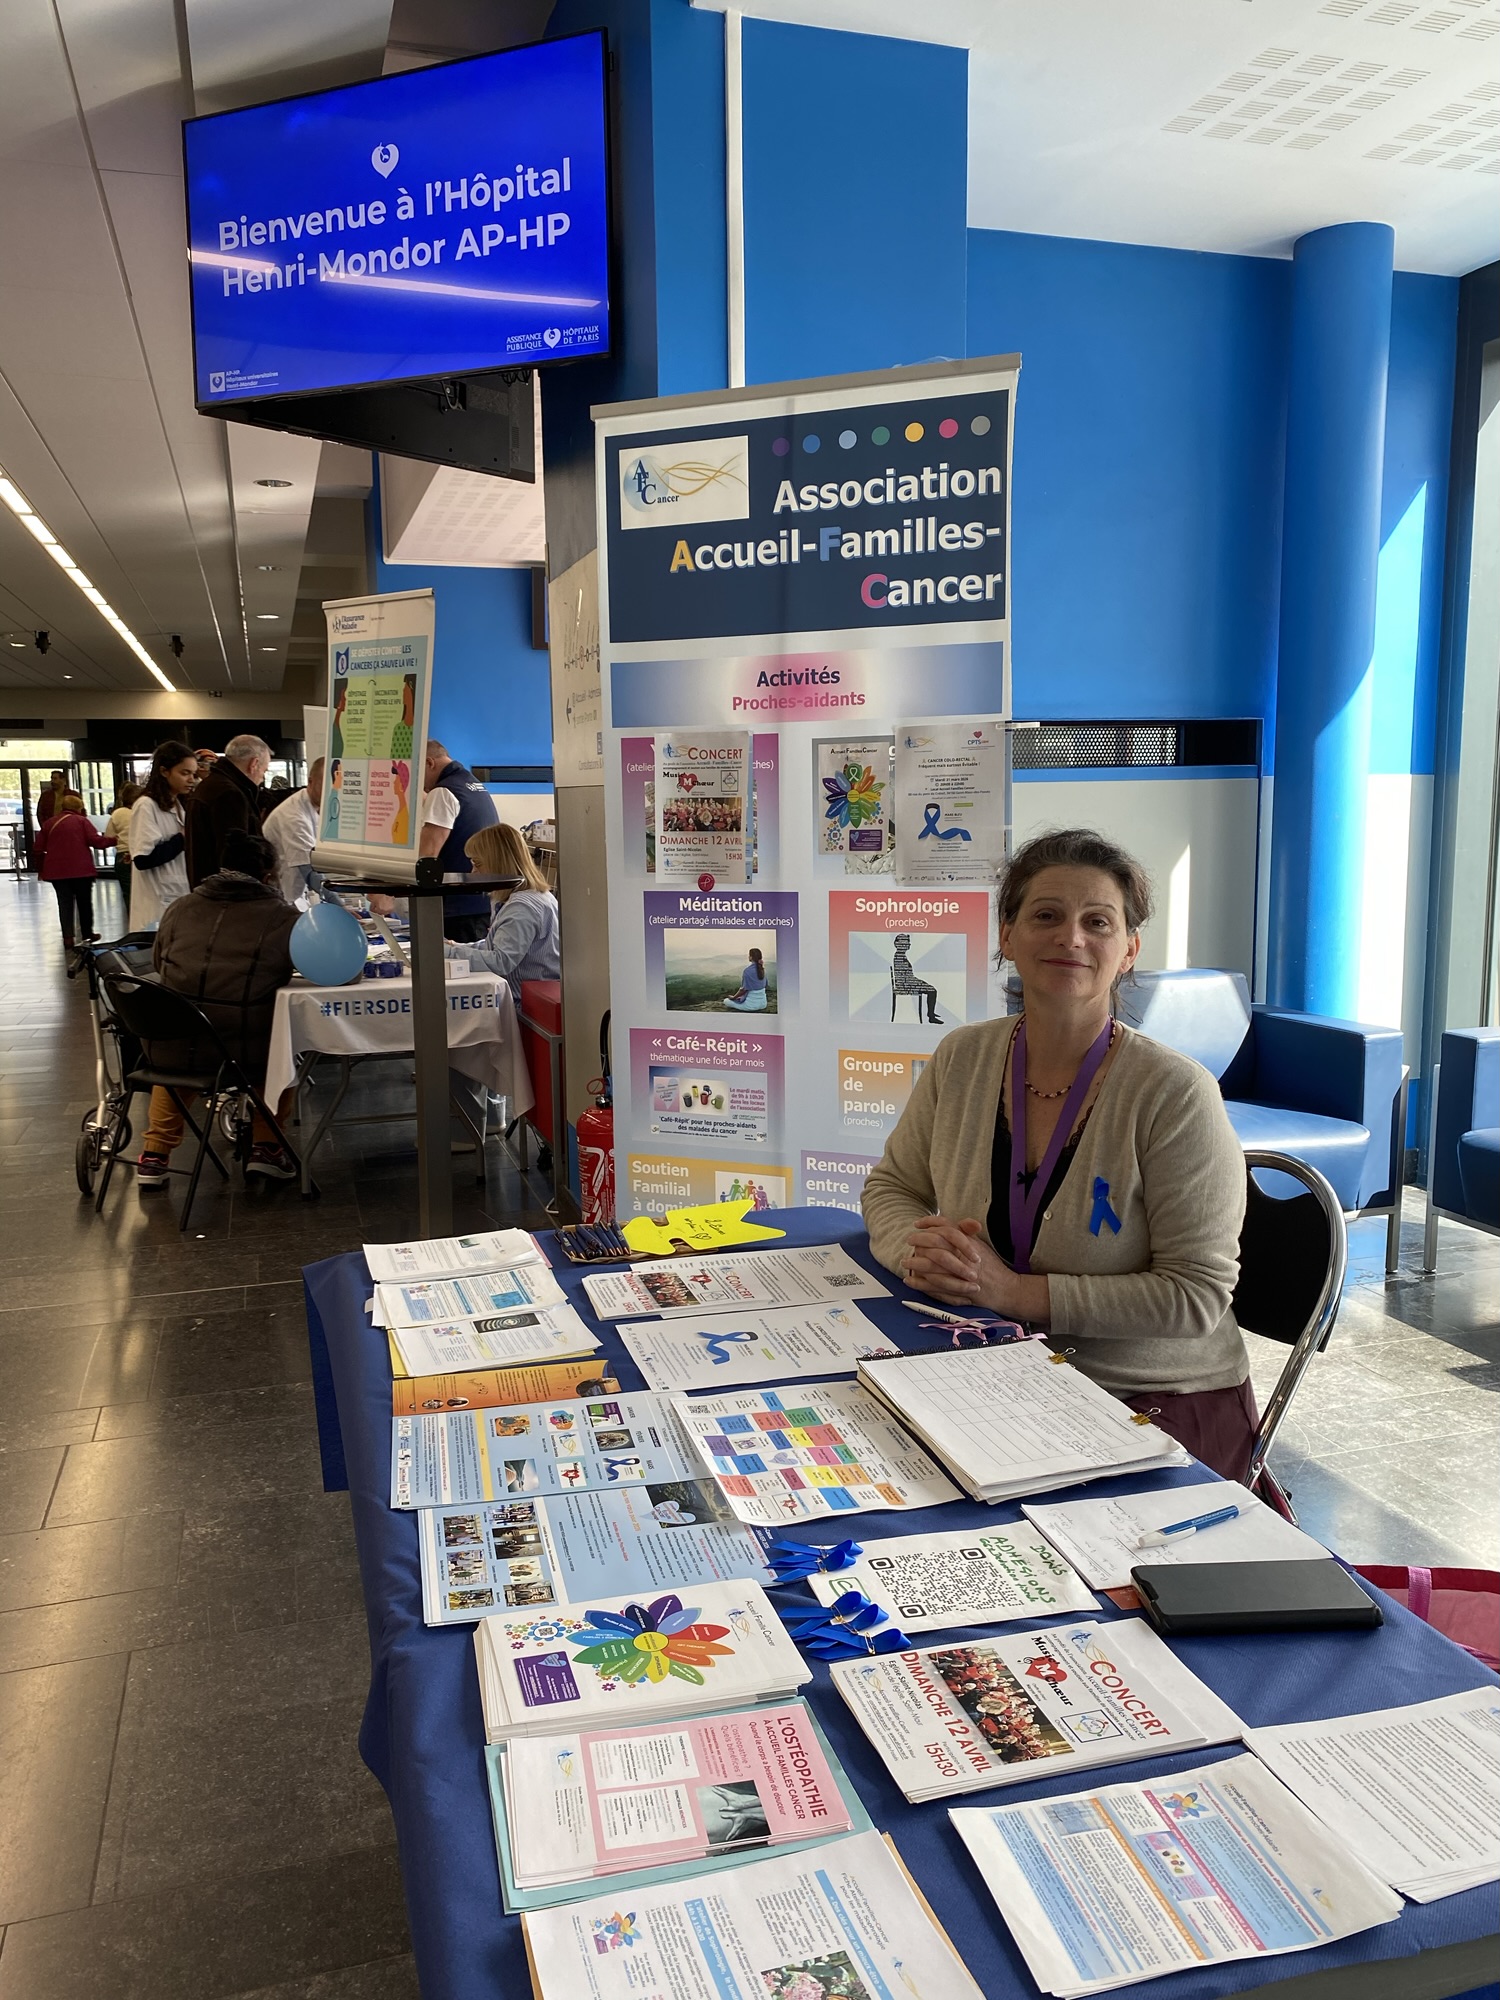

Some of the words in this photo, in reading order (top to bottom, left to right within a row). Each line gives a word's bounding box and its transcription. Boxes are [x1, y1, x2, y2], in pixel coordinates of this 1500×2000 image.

[218, 200, 386, 251] Bienvenue
[397, 187, 414, 219] à
[425, 157, 571, 216] l'Hôpital
[223, 237, 446, 296] Henri-Mondor
[455, 213, 571, 261] AP-HP
[506, 333, 542, 344] ASSISTANCE
[563, 325, 599, 336] HÔPITAUX
[578, 333, 599, 342] PARIS
[506, 341, 542, 351] PUBLIQUE
[773, 462, 1001, 514] Association
[670, 516, 1001, 573] Accueil-Familles-
[861, 572, 1001, 609] Cancer
[341, 622, 357, 630] Maladie
[402, 645, 411, 654] LES
[350, 661, 372, 670] CANCERS
[380, 659, 398, 668] SAUVE
[398, 659, 405, 667] LA
[406, 658, 414, 667] VIE
[756, 665, 840, 688] Activités
[732, 691, 866, 711] Proches-aidants
[688, 748, 742, 760] CONCERT
[684, 778, 692, 786] M
[660, 836, 708, 845] DIMANCHE
[711, 836, 722, 845] 12
[679, 898, 762, 912] Méditation
[855, 898, 960, 916] Sophrologie
[649, 916, 677, 925] (atelier
[679, 916, 710, 926] partagé
[712, 916, 745, 925] malades
[759, 917, 794, 927] proches)
[885, 917, 928, 928] (proches)
[652, 1038, 662, 1048] «
[666, 1036, 748, 1055] Café-Répit
[752, 1043, 762, 1052] »
[650, 1053, 694, 1064] thématique
[713, 1056, 727, 1065] fois
[730, 1059, 743, 1067] par
[745, 1059, 765, 1067] mois
[843, 1057, 904, 1076] Groupe
[843, 1077, 863, 1091] de
[844, 1100, 896, 1114] parole
[714, 1121, 757, 1129] proches-aidants
[843, 1116, 884, 1129] (proches)
[632, 1161, 689, 1177] Soutien
[806, 1157, 873, 1175] Rencont
[633, 1180, 691, 1196] Familial
[806, 1179, 849, 1194] entre
[633, 1197, 642, 1211] à
[807, 1197, 862, 1214] Endeui
[1028, 1543, 1068, 1576] DONS
[744, 1599, 759, 1615] Accueil
[753, 1614, 769, 1630] Famille
[761, 1630, 778, 1646] Cancer
[1029, 1636, 1062, 1665] Music'
[1034, 1663, 1057, 1676] M
[876, 1661, 892, 1676] place
[901, 1699, 925, 1725] Saint-Maur
[885, 1660, 904, 1676] Eglise
[896, 1676, 926, 1709] Saint-Nicolas
[896, 1651, 959, 1717] DIMANCHE
[1043, 1676, 1076, 1706] Chœur
[1084, 1674, 1148, 1739] Accueil-Familles-Cancer
[1085, 1659, 1175, 1737] CONCERT
[747, 1721, 761, 1738] Quand
[942, 1718, 971, 1736] 12
[719, 1725, 732, 1742] Quels
[726, 1743, 742, 1772] bénéfices
[729, 1723, 749, 1764] L'ostéopathie
[755, 1745, 766, 1760] corps
[922, 1741, 959, 1777] 15H30
[955, 1737, 993, 1773] AVRIL
[764, 1725, 782, 1754] ACCUEIL
[775, 1754, 794, 1788] FAMILLES
[787, 1788, 805, 1819] CANCER
[764, 1765, 776, 1783] besoin
[776, 1716, 828, 1817] L'OSTÉOPATHIE
[770, 1783, 779, 1791] de
[773, 1792, 787, 1815] douceur
[693, 1900, 708, 1926] L'atelier
[839, 1885, 851, 1899] pour
[847, 1900, 856, 1908] les
[853, 1910, 870, 1935] malades
[840, 1872, 853, 1888] Fiche
[849, 1889, 863, 1908] Atelier
[861, 1914, 887, 1950] Sophrologie
[848, 1875, 890, 1943] Accueil-Familles-Cancer
[686, 1903, 695, 1916] 14h
[693, 1921, 705, 1941] 15h30
[704, 1926, 711, 1934] de
[830, 1901, 842, 1912] Des
[837, 1913, 849, 1925] clés
[843, 1926, 856, 1940] pour
[852, 1941, 861, 1949] un
[857, 1950, 881, 1984] mieux-être
[707, 1935, 727, 1974] Sophrologie,
[723, 1976, 732, 1984] le
